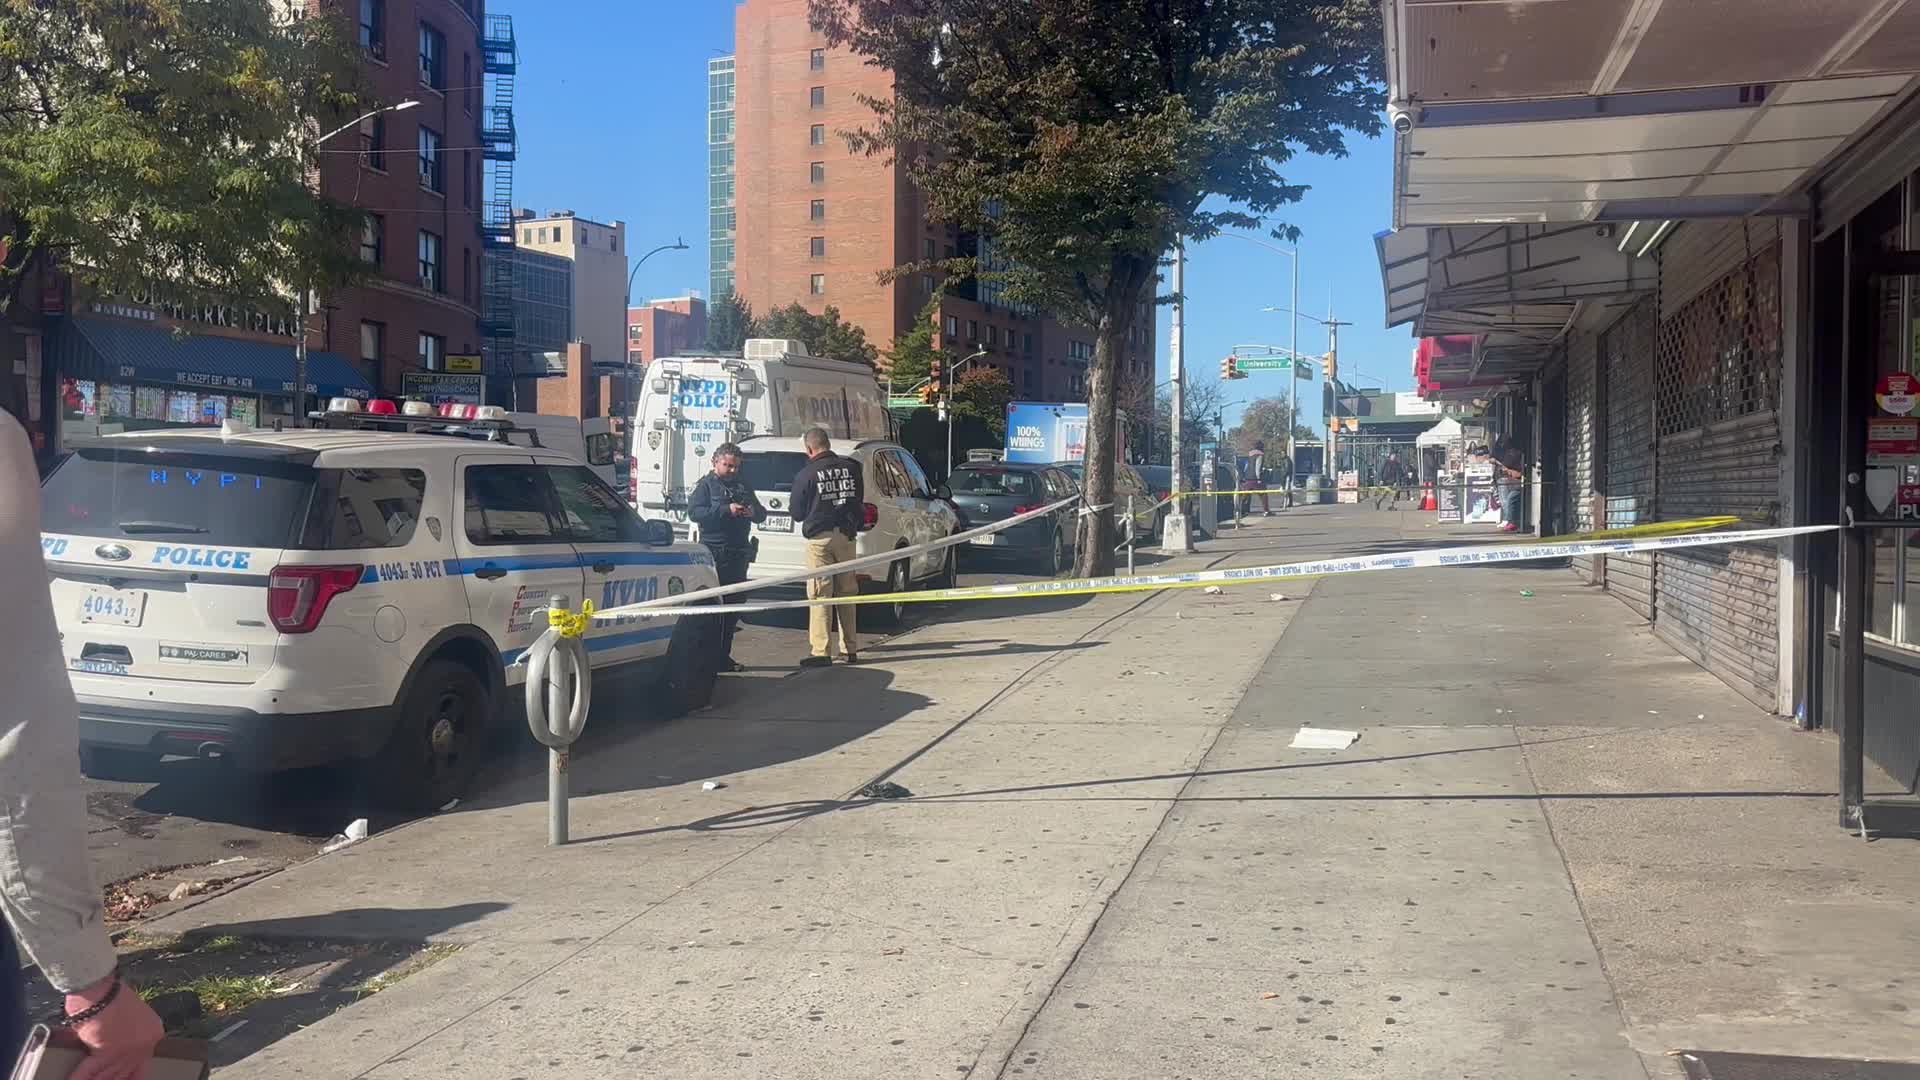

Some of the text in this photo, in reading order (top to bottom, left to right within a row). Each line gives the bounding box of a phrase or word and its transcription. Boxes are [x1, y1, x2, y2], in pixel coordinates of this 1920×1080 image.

[1243, 360, 1281, 369] University
[187, 373, 210, 385] ACCEPT
[211, 375, 222, 385] EBT
[680, 379, 727, 394] NYPD
[1016, 425, 1041, 437] 100%
[691, 433, 712, 442] UNIT
[816, 467, 853, 481] N.Y.P.D.
[816, 479, 856, 494] POLICE
[151, 546, 250, 570] POLICE
[380, 562, 404, 582] 4043
[411, 563, 422, 580] 50
[424, 561, 442, 577] PCT
[1254, 568, 1263, 577] DO
[1269, 567, 1281, 577] LINE
[1282, 565, 1302, 576] POLICE
[84, 595, 124, 615] 4043
[199, 651, 227, 659] CARES
